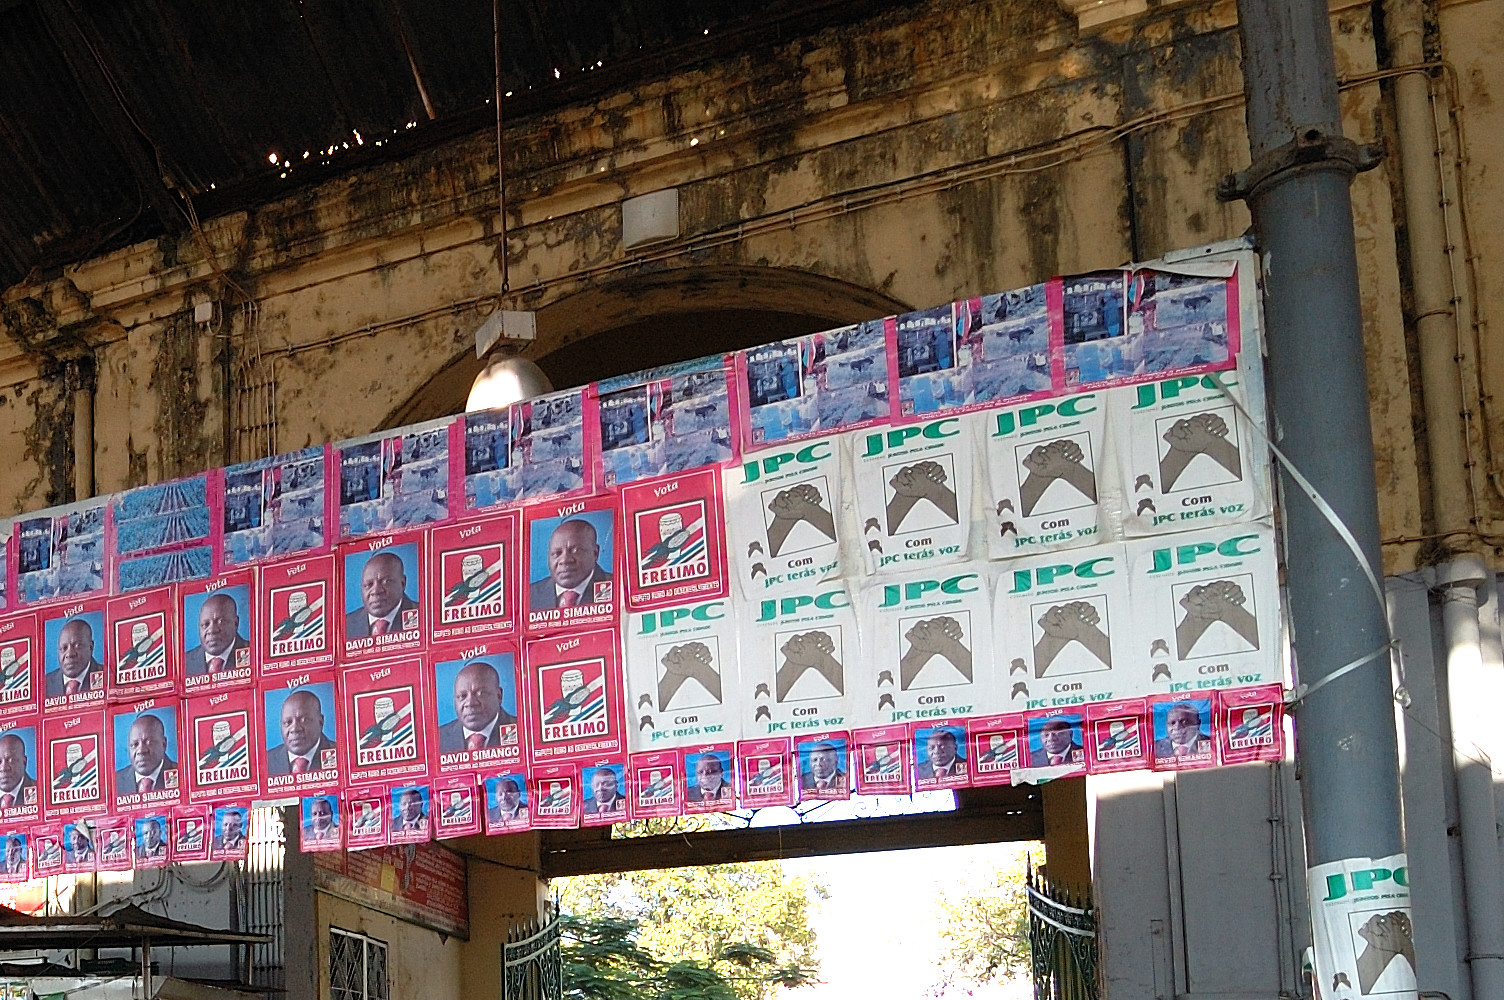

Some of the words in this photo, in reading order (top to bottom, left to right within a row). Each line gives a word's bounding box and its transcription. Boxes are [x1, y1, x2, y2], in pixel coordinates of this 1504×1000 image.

[1131, 371, 1240, 409] JPC
[992, 394, 1097, 437] JPC
[861, 418, 960, 457] JPC
[740, 441, 832, 484] JPC
[653, 480, 679, 497] Vota
[557, 501, 585, 517] Vota
[1181, 495, 1212, 507] Com
[1153, 513, 1176, 526] JPC
[1180, 506, 1215, 520] terás
[1219, 503, 1244, 514] voz
[459, 523, 482, 539] Vota
[1041, 517, 1070, 530] Com
[368, 535, 393, 550] Vota
[905, 536, 932, 548] Com
[1014, 536, 1037, 548] JPC
[1040, 529, 1072, 543] terás
[788, 556, 813, 569] Com
[880, 554, 899, 567] JPC
[903, 548, 935, 560] terás
[939, 545, 961, 555] voz
[1146, 534, 1261, 574] JPC
[286, 562, 306, 576] Vota
[641, 564, 707, 584] FRELIMO
[764, 574, 783, 588] JPC
[786, 567, 816, 581] terás
[1008, 557, 1115, 594] JPC
[205, 577, 227, 592] Vota
[878, 573, 979, 608] JPC
[64, 604, 84, 617] Vota
[129, 596, 146, 609] Vota
[755, 590, 850, 623] JPC
[444, 602, 502, 621] FRELIMO
[529, 611, 560, 623] DAVID
[564, 604, 613, 618] SIMANGO
[637, 602, 725, 635] JPC
[0, 621, 15, 633] Vota
[272, 637, 323, 655] FRELIMO
[346, 637, 373, 650] DAVID
[376, 630, 420, 645] SIMANGO
[556, 638, 580, 653] Vota
[460, 644, 487, 660] Vota
[118, 665, 164, 682] FRELIMO
[185, 674, 210, 687] DAVID
[212, 668, 251, 682] SIMANGO
[369, 667, 391, 682] Vota
[1198, 664, 1229, 675] Com
[286, 673, 310, 689] Vota
[1053, 680, 1083, 692] Com
[1169, 681, 1193, 692] JPC
[1197, 675, 1232, 689] terás
[1237, 673, 1262, 683] voz
[44, 695, 67, 707] DAVID
[69, 690, 105, 704] SIMANGO
[134, 699, 155, 713] Vota
[209, 694, 228, 706] Vota
[918, 694, 945, 705] Com
[1026, 698, 1048, 710] JPC
[1051, 694, 1085, 707] terás
[1089, 692, 1113, 702] voz
[674, 715, 698, 725] Com
[792, 706, 818, 717] Com
[891, 710, 912, 722] JPC
[916, 706, 946, 718] terás
[951, 704, 973, 714] voz
[64, 717, 81, 729] Vota
[545, 720, 606, 740] FRELIMO
[768, 721, 787, 733] JPC
[790, 717, 820, 730] terás
[824, 717, 844, 726] voz
[651, 729, 669, 741] JPC
[673, 725, 700, 736] terás
[704, 724, 724, 733] voz
[359, 745, 415, 763] FRELIMO
[440, 751, 470, 765] DAVID
[472, 746, 520, 761] SIMANGO
[199, 767, 248, 783] FRELIMO
[267, 774, 294, 786] DAVID
[296, 770, 338, 784] SIMANGO
[53, 787, 97, 802] FRELIMO
[116, 795, 140, 806] DAVID
[142, 789, 180, 803] SIMANGO
[4, 806, 39, 817] SIMANGO
